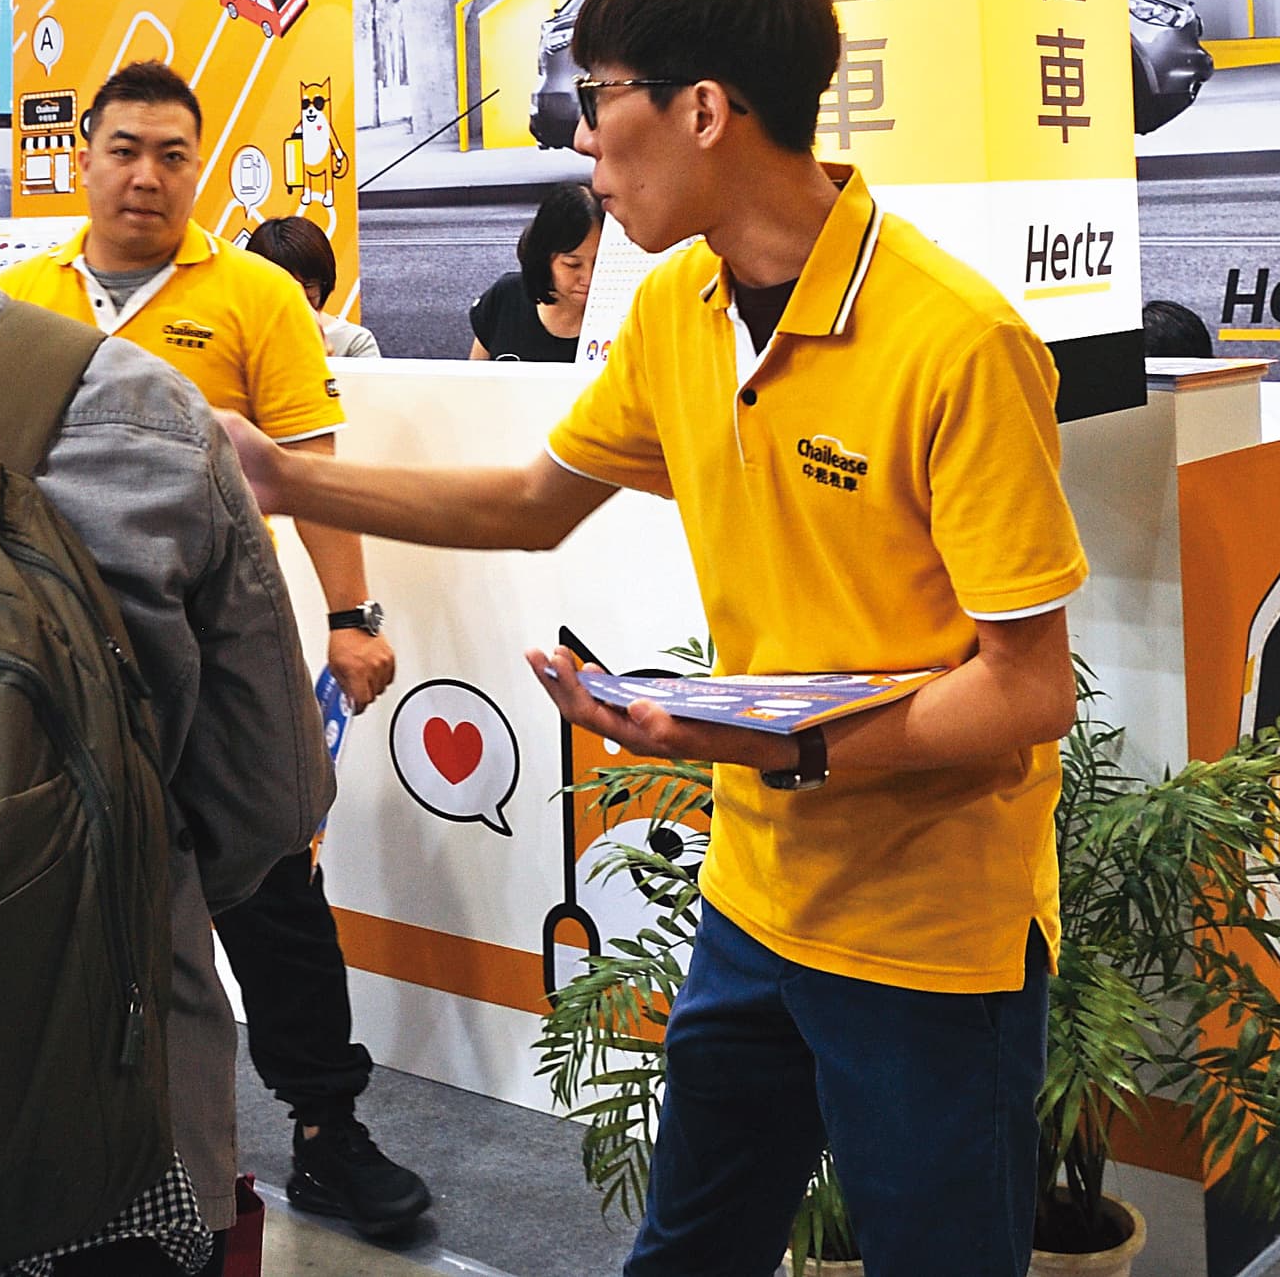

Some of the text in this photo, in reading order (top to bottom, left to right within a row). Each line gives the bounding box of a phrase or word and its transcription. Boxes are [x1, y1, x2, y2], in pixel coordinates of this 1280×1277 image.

[40, 27, 54, 51] A
[1026, 222, 1114, 283] Hertz
[797, 438, 869, 476] Chailease
